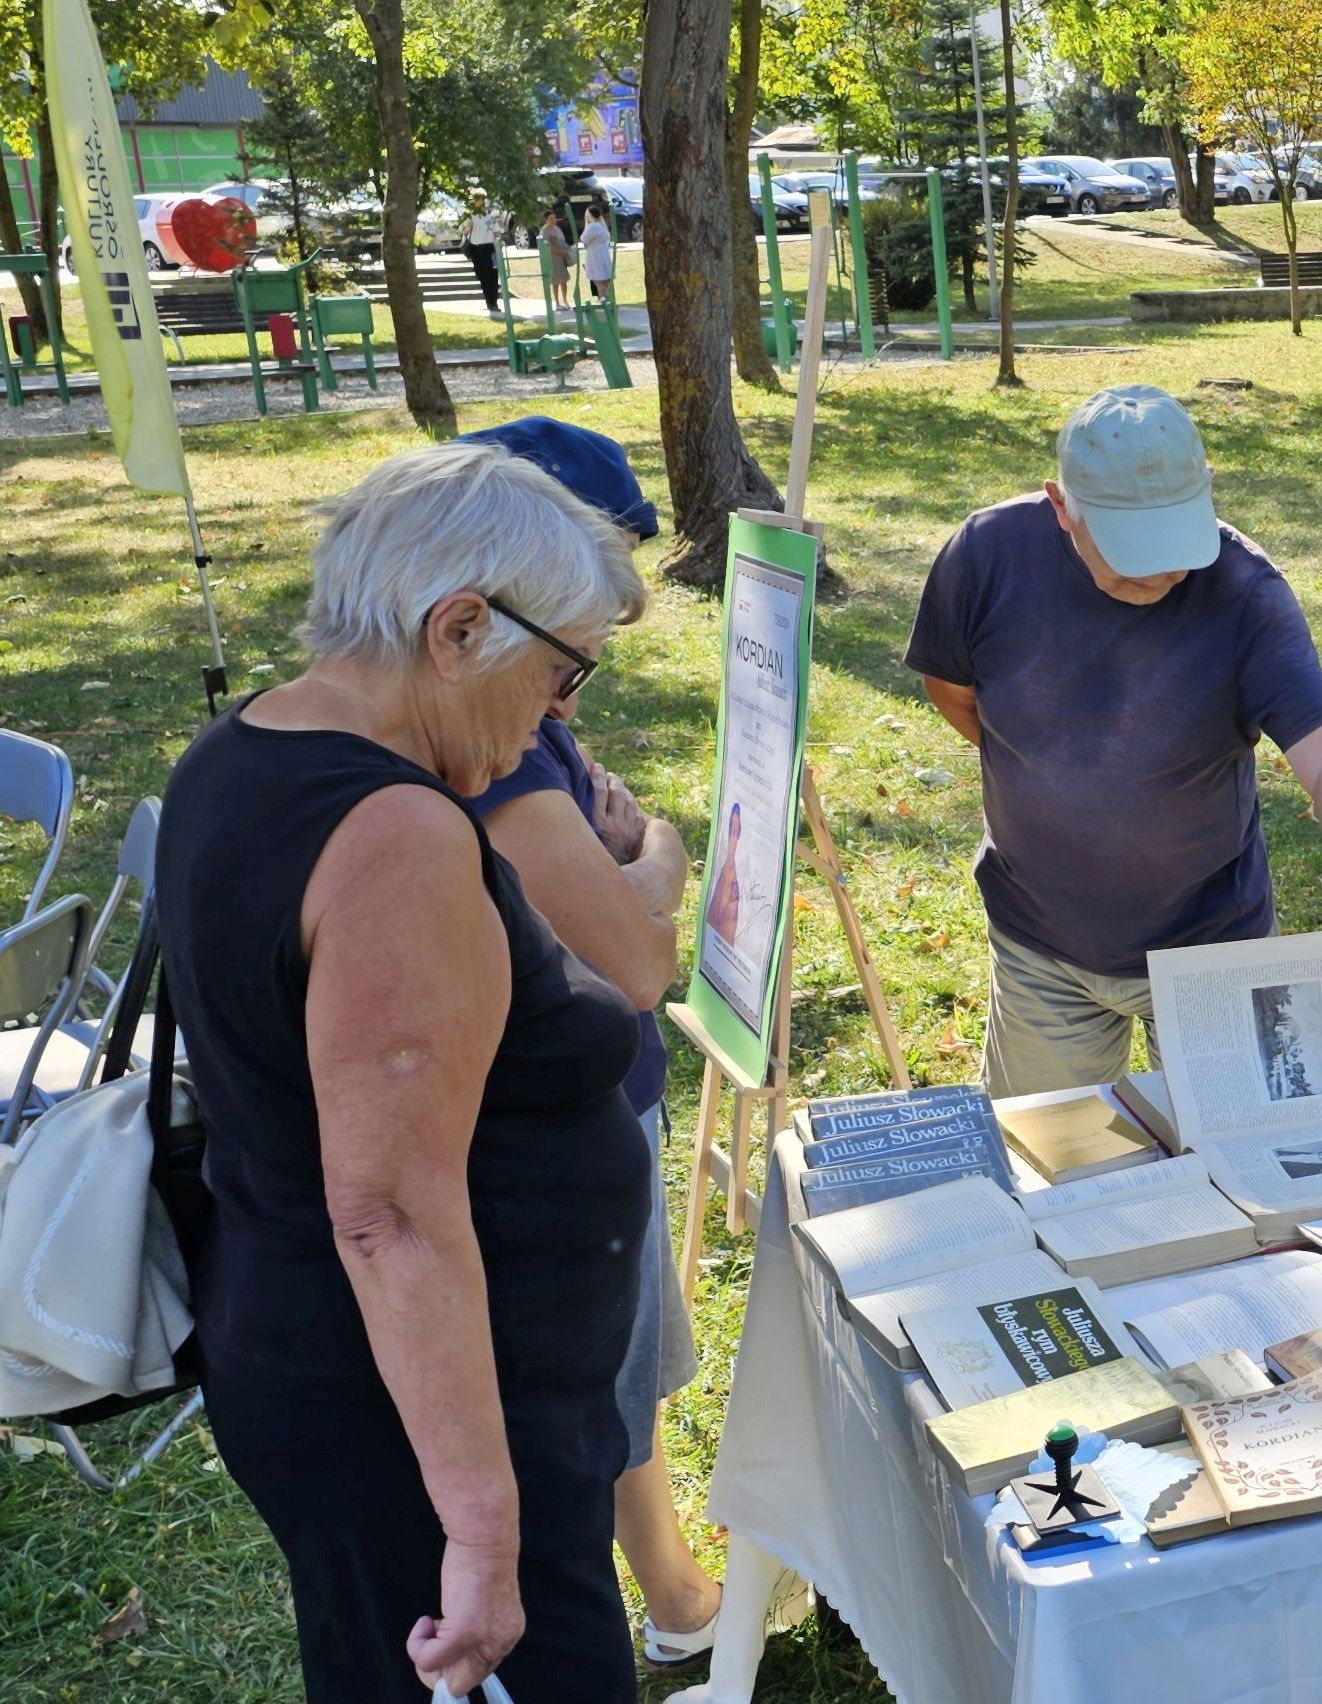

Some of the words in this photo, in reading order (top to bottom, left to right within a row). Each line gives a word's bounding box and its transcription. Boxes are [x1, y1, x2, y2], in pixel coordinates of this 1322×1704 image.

[735, 632, 783, 680] KORDIAN
[822, 1108, 896, 1138] Juliusz
[898, 1095, 986, 1123] Słowacki
[818, 1137, 888, 1165] Juliusz
[889, 1114, 977, 1145] Słowacki
[812, 1163, 886, 1191] Juliusz
[887, 1148, 979, 1176] Słowacki
[1030, 1328, 1058, 1355] rym
[1062, 1307, 1106, 1357] Juliusza
